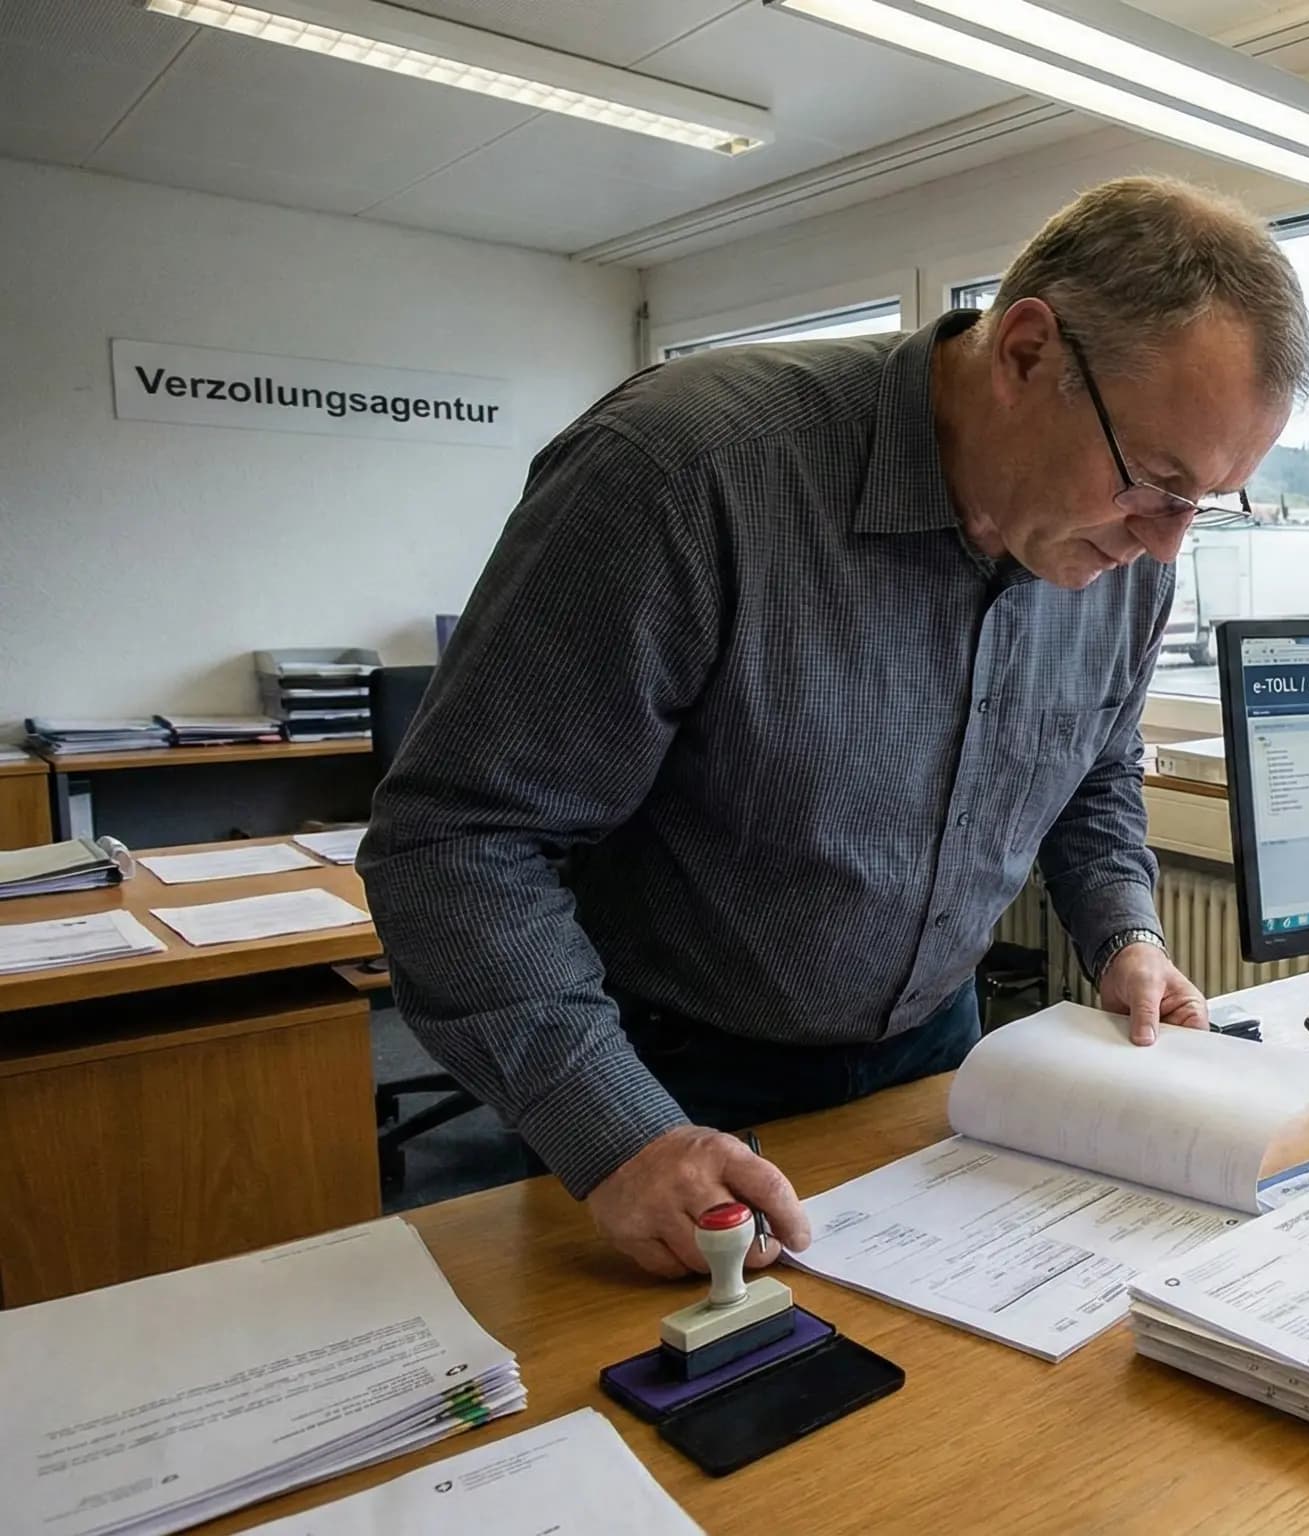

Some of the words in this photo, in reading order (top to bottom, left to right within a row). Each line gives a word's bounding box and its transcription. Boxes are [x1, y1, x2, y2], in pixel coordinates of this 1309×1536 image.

[135, 366, 500, 424] Verzollungsagentur
[1252, 677, 1298, 694] e-TOLL
[1300, 676, 1305, 692] /
